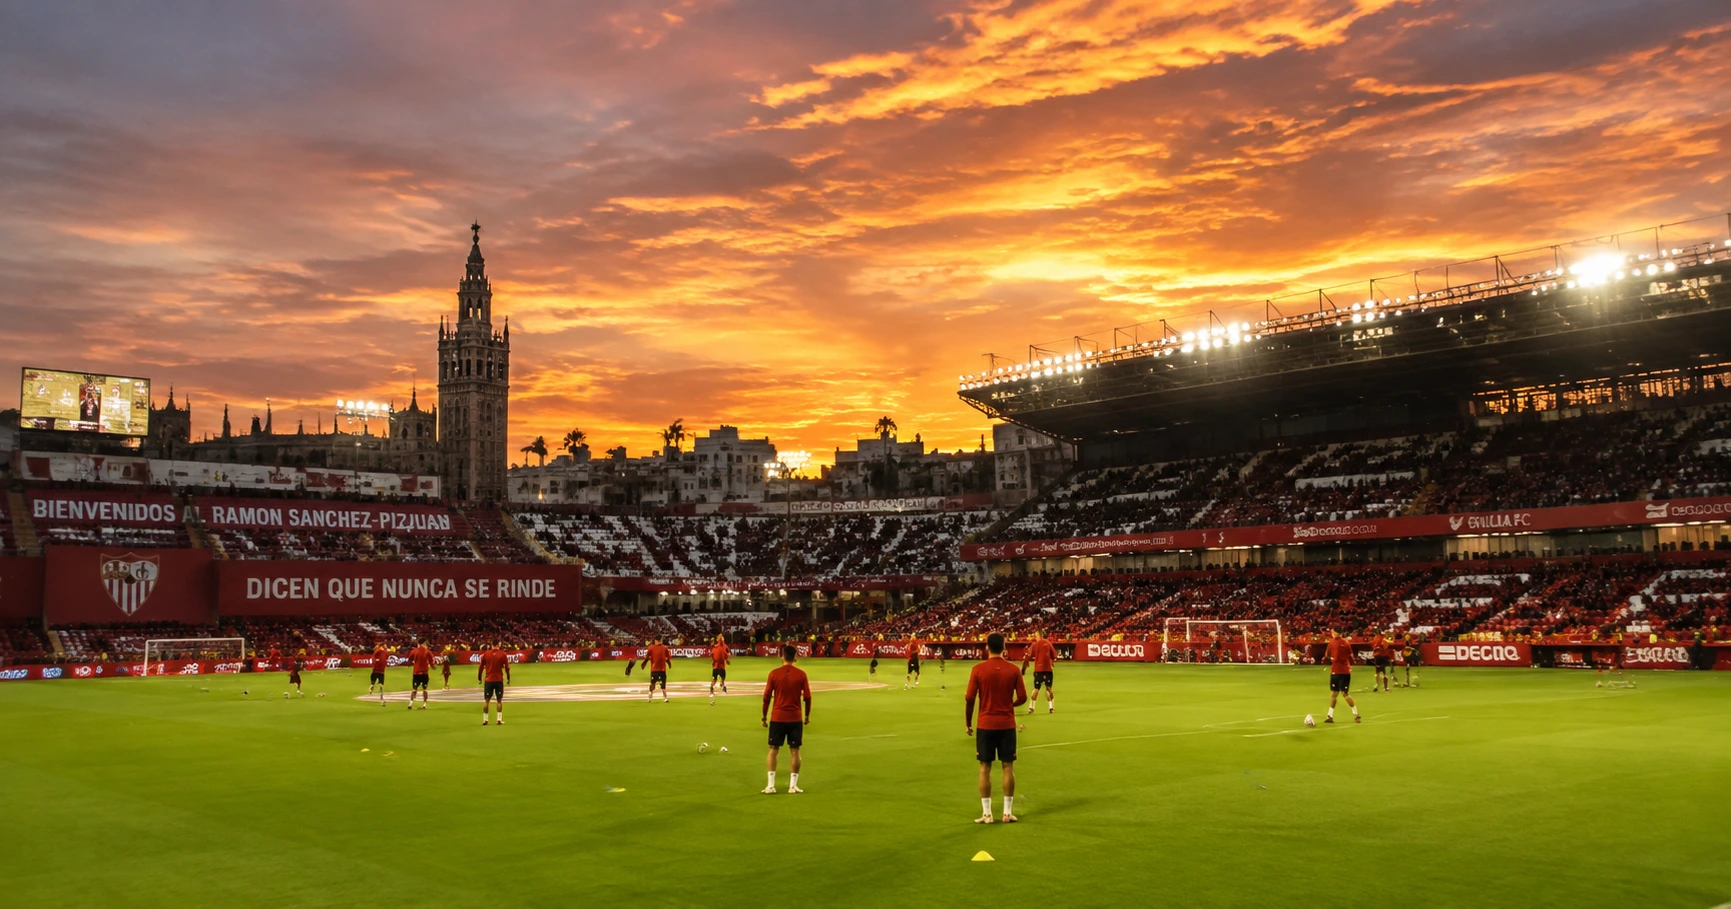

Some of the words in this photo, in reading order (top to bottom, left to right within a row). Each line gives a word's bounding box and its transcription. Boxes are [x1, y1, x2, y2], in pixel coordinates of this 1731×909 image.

[33, 499, 176, 522] BIENVENIDOS
[212, 505, 283, 526] RAMON
[246, 577, 320, 599] DICEN
[327, 577, 374, 602] QUE
[382, 578, 458, 599] NUNCA
[465, 578, 490, 599] SE
[497, 579, 556, 598] RINDE
